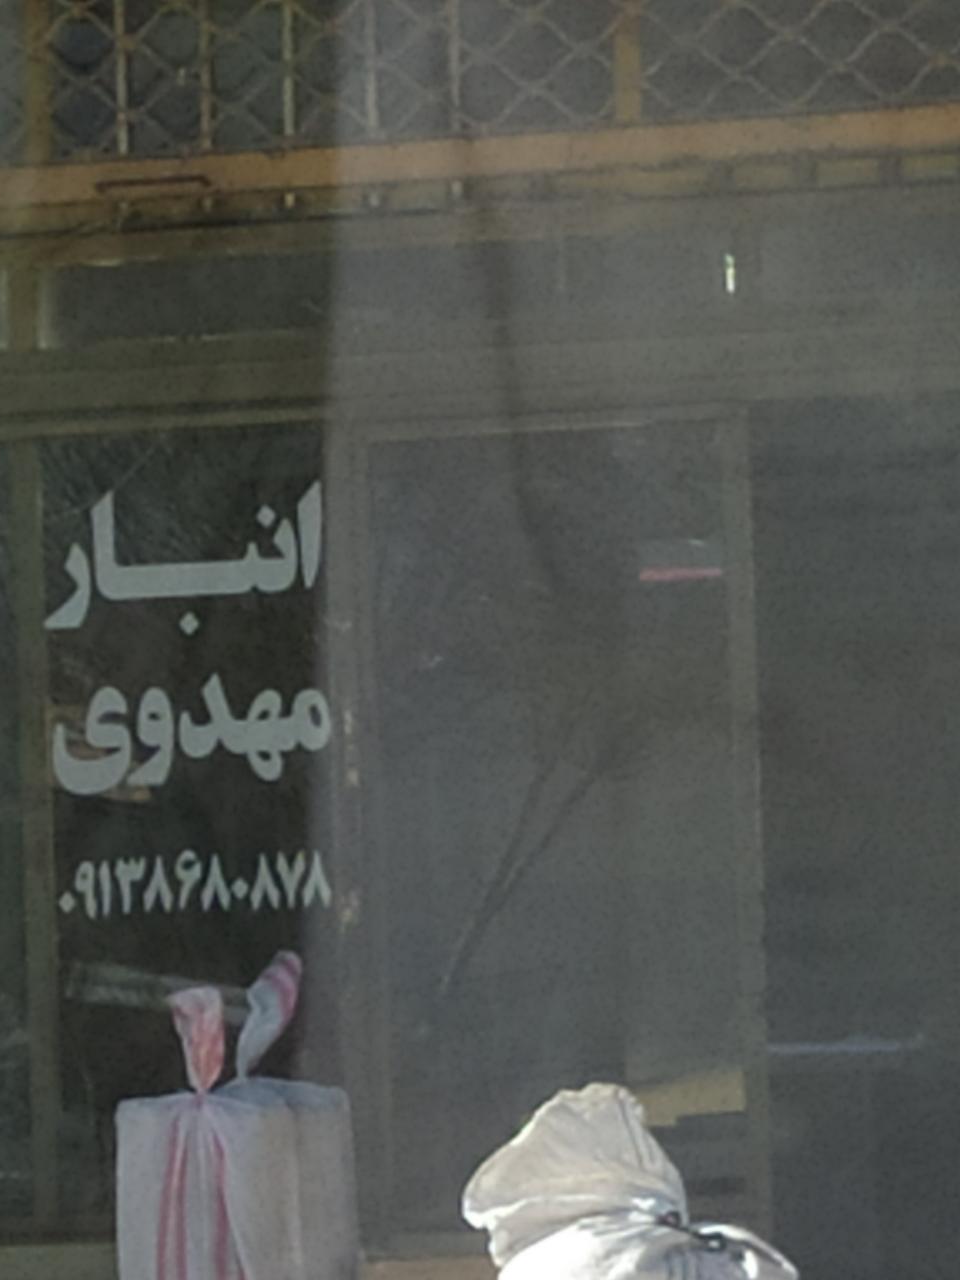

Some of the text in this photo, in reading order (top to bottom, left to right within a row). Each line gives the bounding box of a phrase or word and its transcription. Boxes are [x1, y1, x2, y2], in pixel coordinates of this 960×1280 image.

[43, 479, 323, 635] انبار
[52, 672, 331, 795] مهدوی
[59, 849, 332, 920] ۰۹۱۳۸۶۸۰۸۷۸
